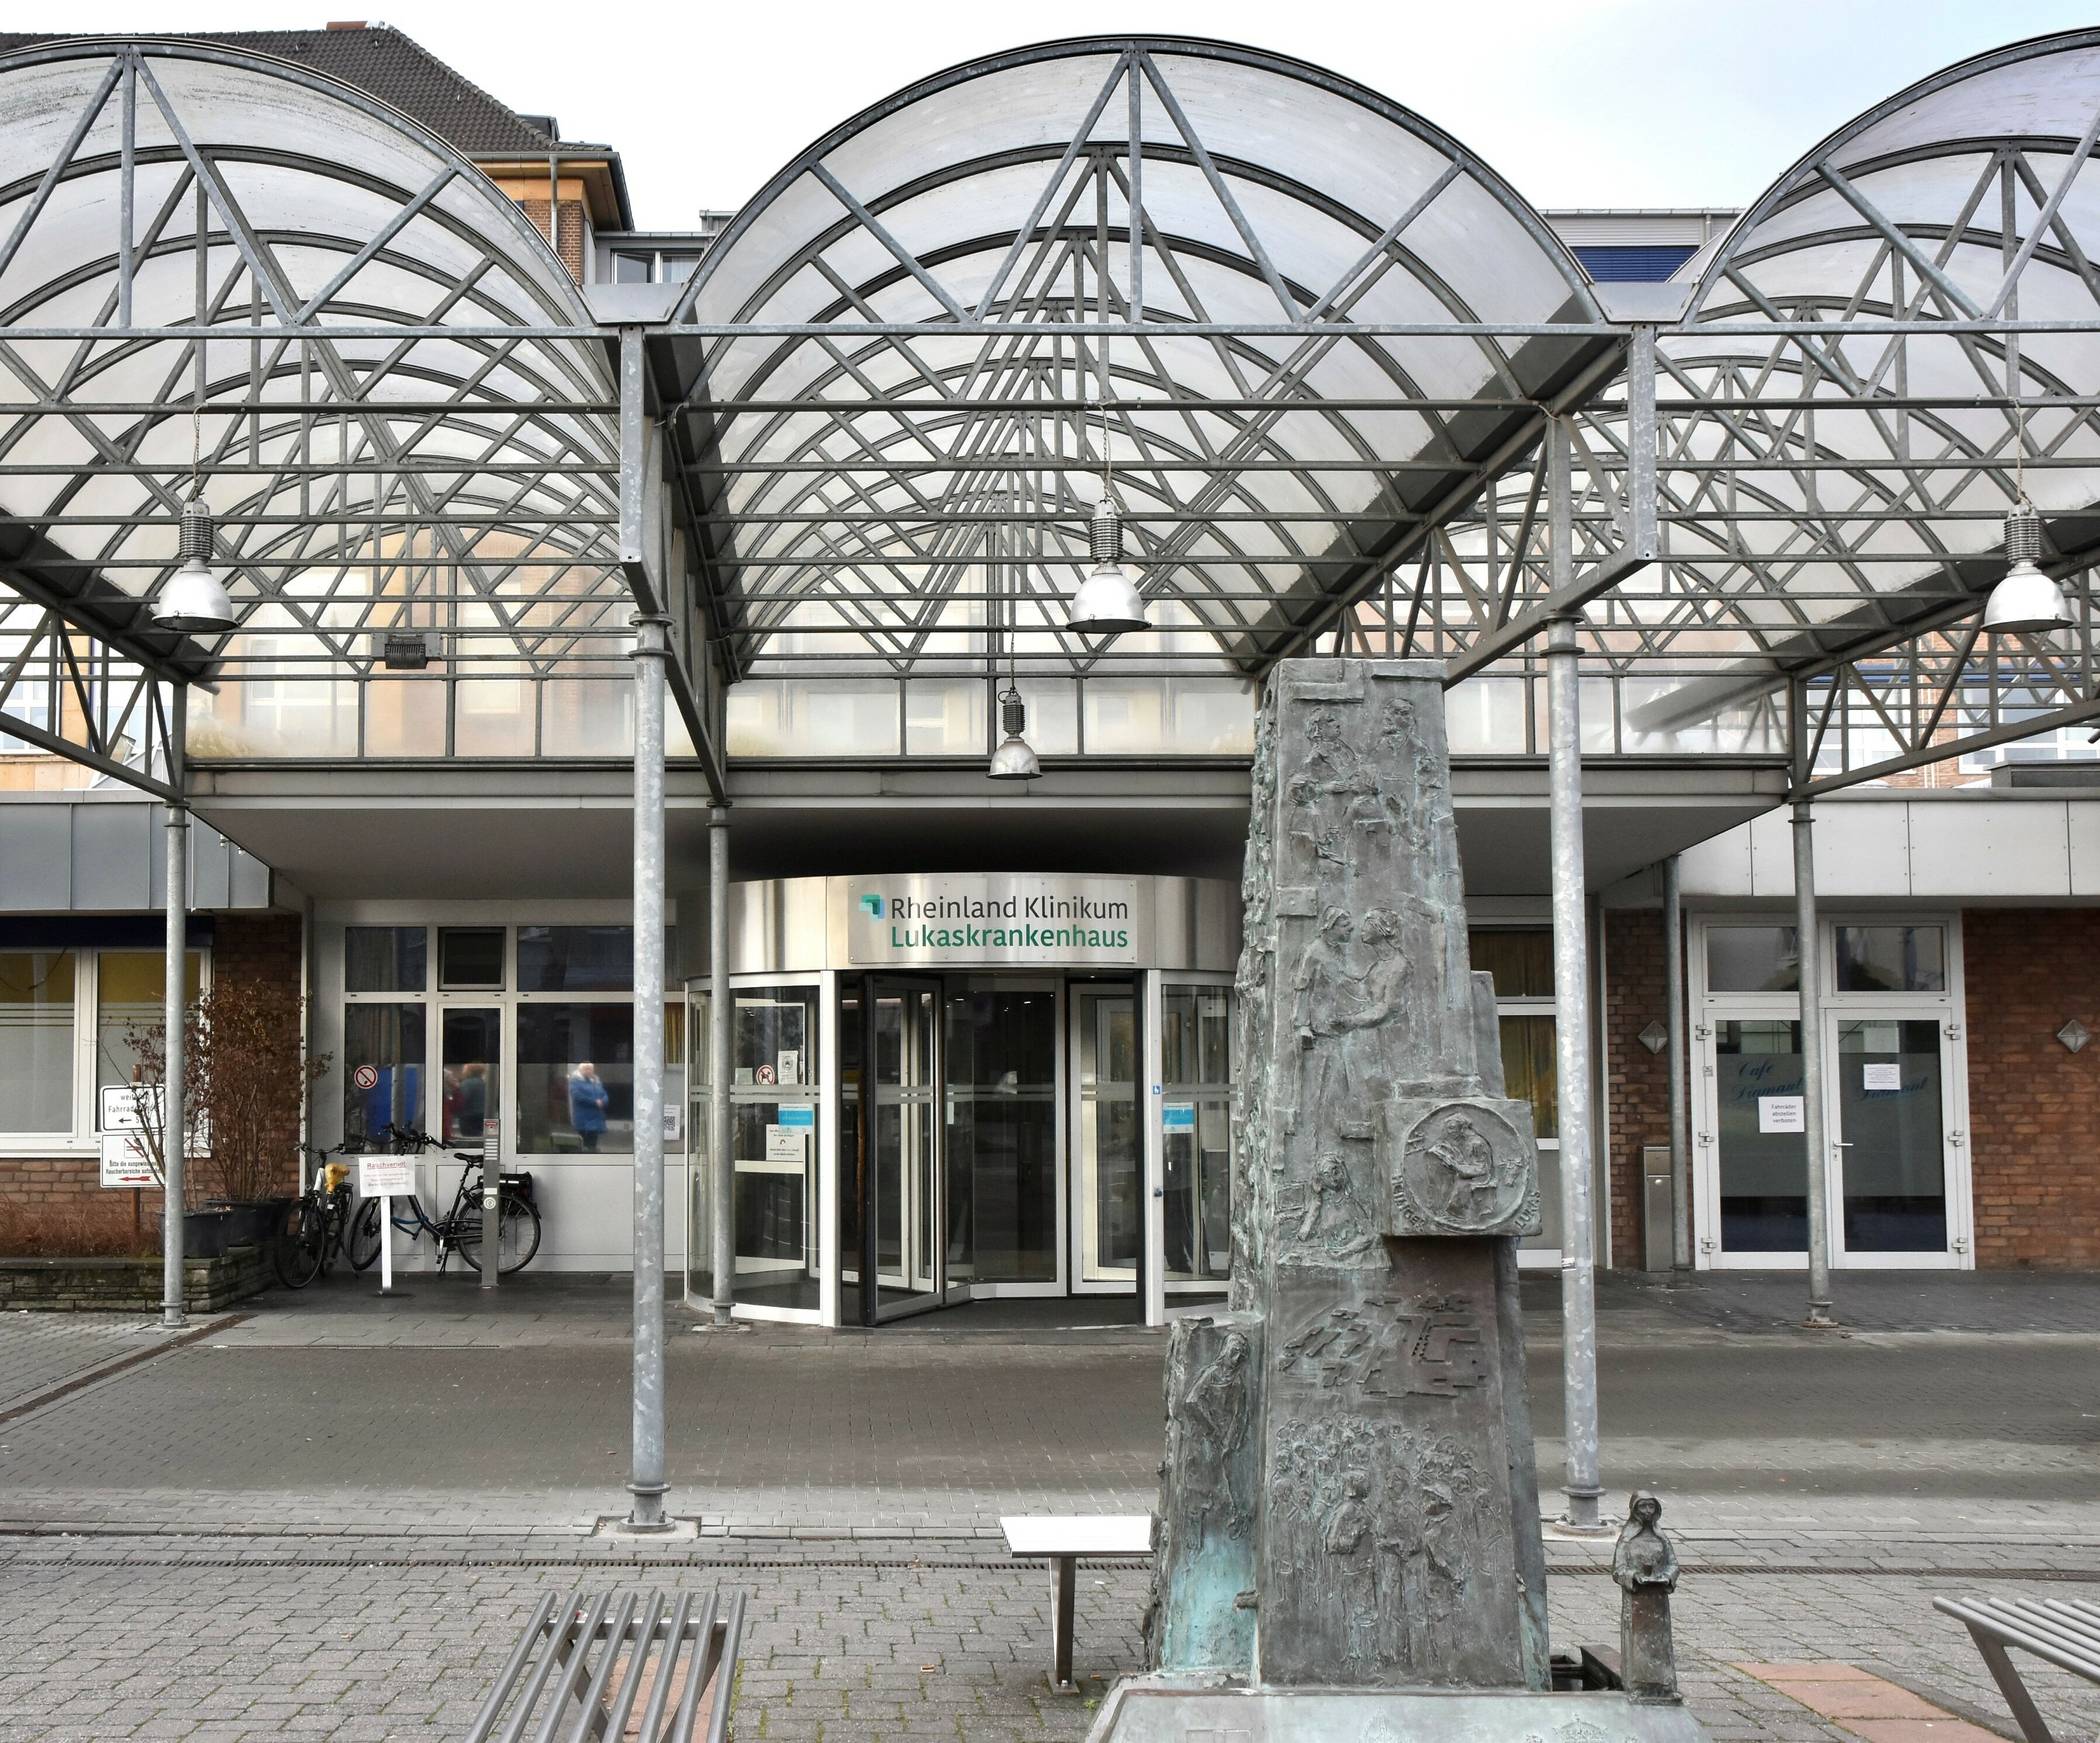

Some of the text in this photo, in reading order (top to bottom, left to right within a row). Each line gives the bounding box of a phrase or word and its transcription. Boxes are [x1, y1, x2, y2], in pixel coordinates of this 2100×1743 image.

[891, 896, 1128, 920] Rheinland Klinikum
[891, 924, 1128, 948] Lukaskrankenhaus
